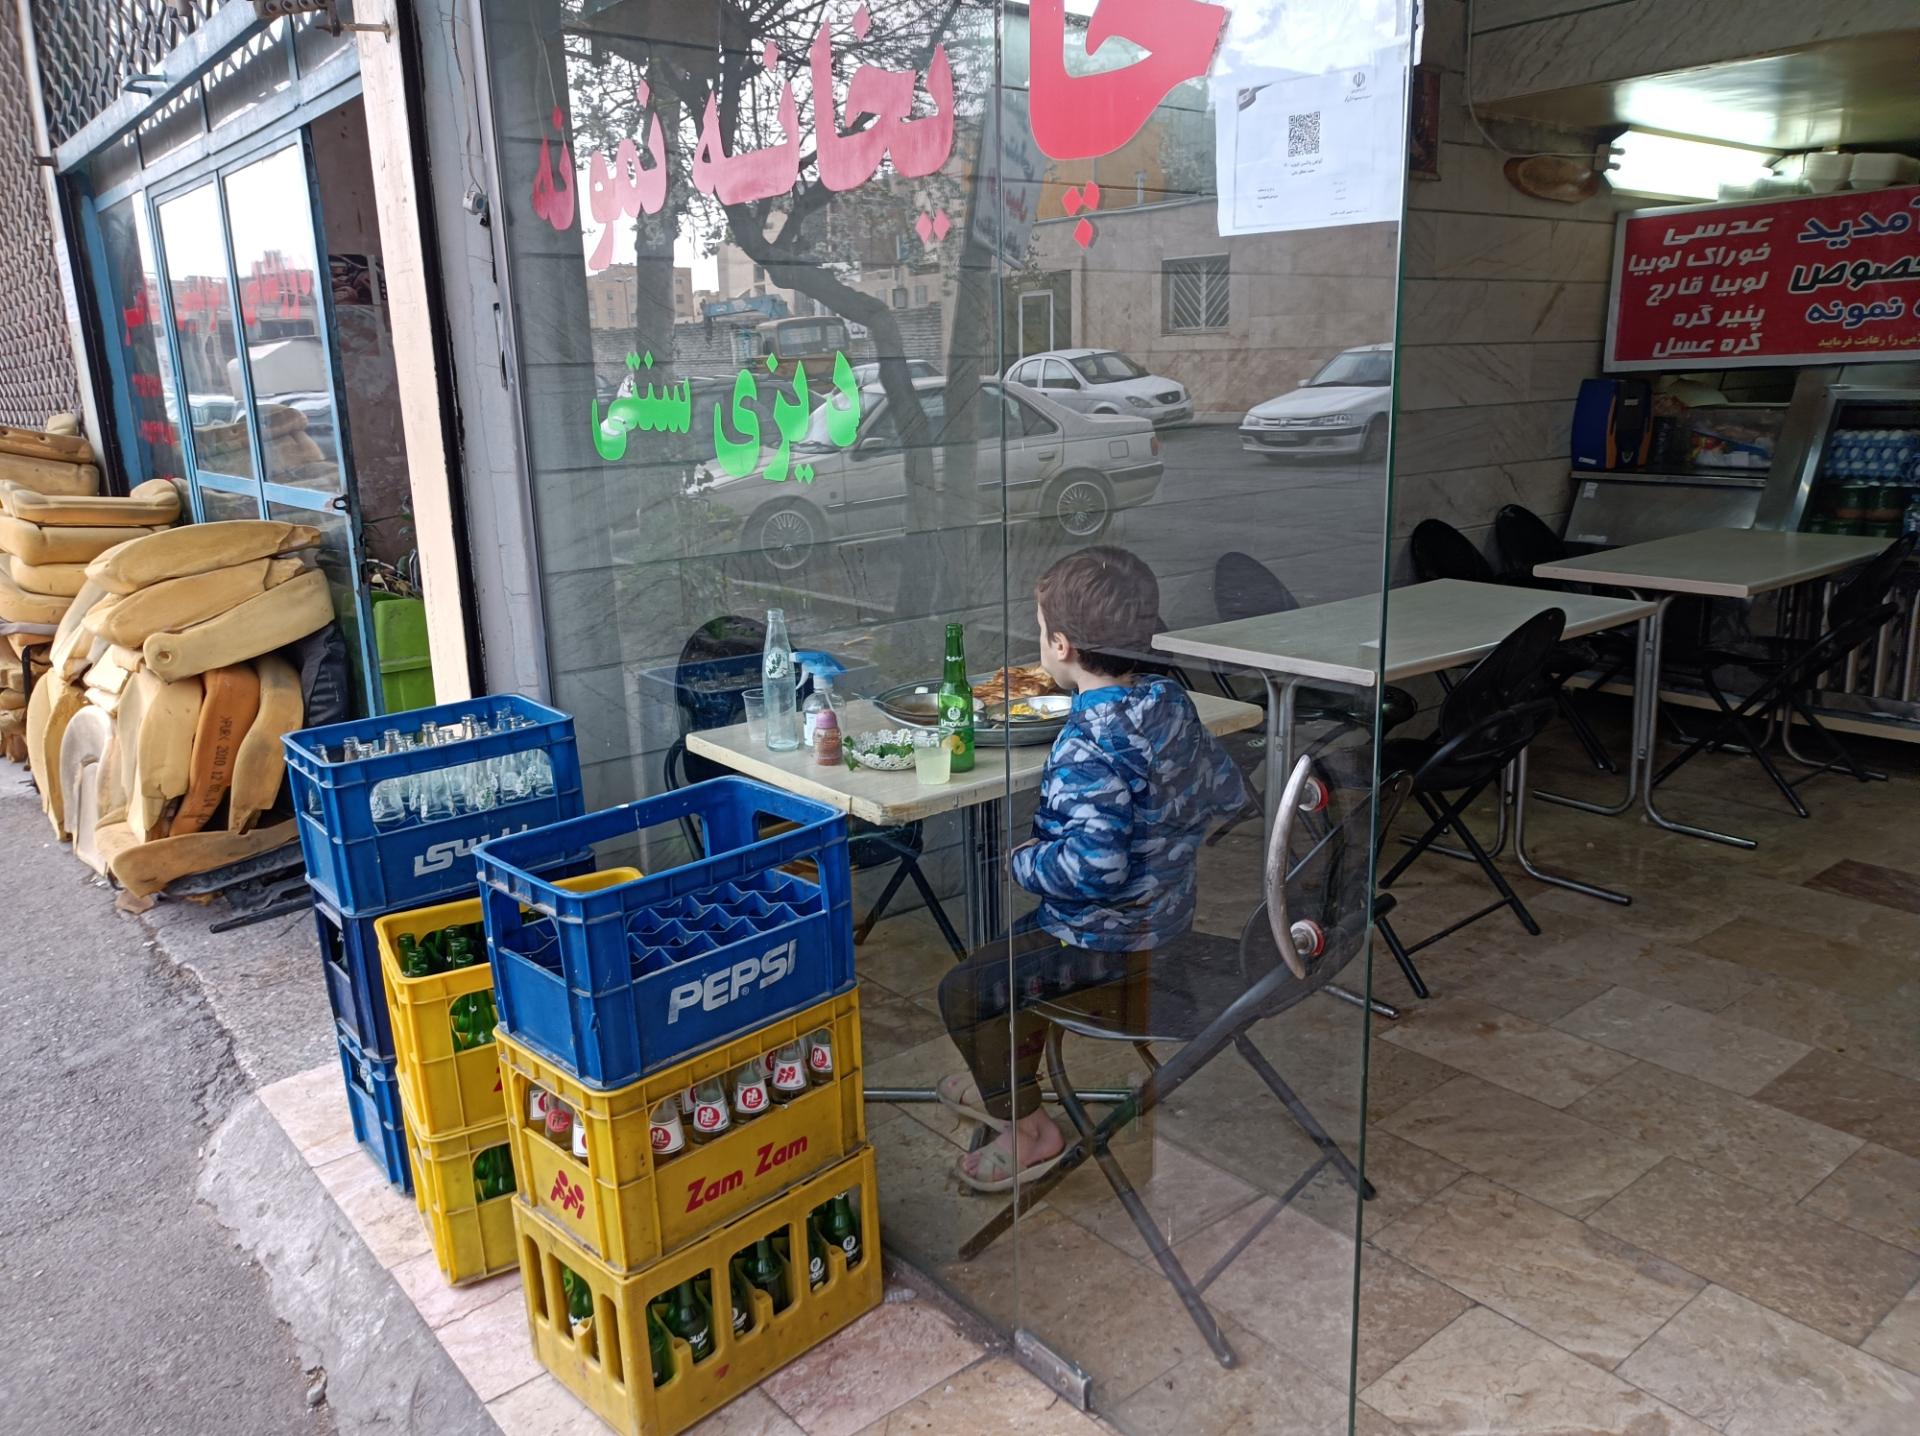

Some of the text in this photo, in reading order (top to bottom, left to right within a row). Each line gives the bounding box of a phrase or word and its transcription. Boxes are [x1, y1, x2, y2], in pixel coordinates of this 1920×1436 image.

[1663, 217, 1775, 246] عدسی
[1628, 242, 1772, 275] خوراک لوبیا
[1645, 271, 1769, 307] لوبیا قارچ
[1716, 303, 1766, 331] پنیر
[1805, 296, 1906, 330] نمونه
[1651, 336, 1715, 359] عسل
[592, 350, 861, 485] دیزی سنتی
[667, 938, 798, 1024] PEPSI
[685, 1135, 808, 1213] Zam Zam
